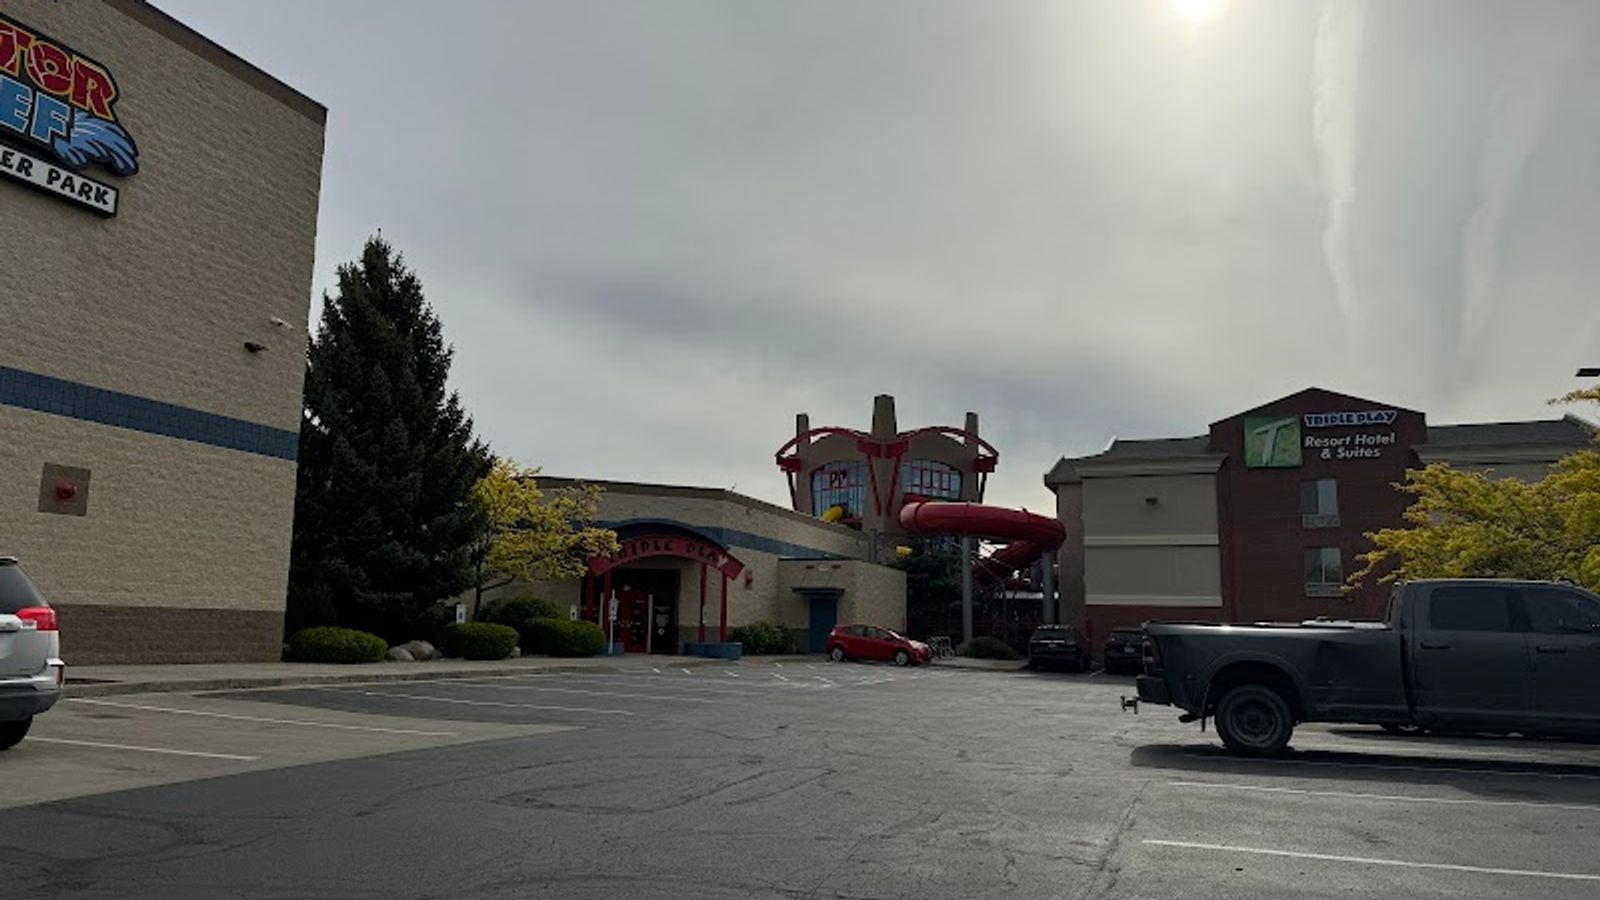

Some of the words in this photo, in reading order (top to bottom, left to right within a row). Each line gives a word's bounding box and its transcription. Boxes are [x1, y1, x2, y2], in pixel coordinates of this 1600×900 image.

[0, 151, 34, 177] ER
[46, 167, 109, 206] PARK
[1305, 413, 1355, 426] TRIPLE
[1355, 411, 1396, 424] PLAY
[1304, 435, 1351, 447] Resort
[1354, 432, 1396, 445] Hotel
[1320, 449, 1332, 459] &
[1336, 446, 1381, 459] Suites
